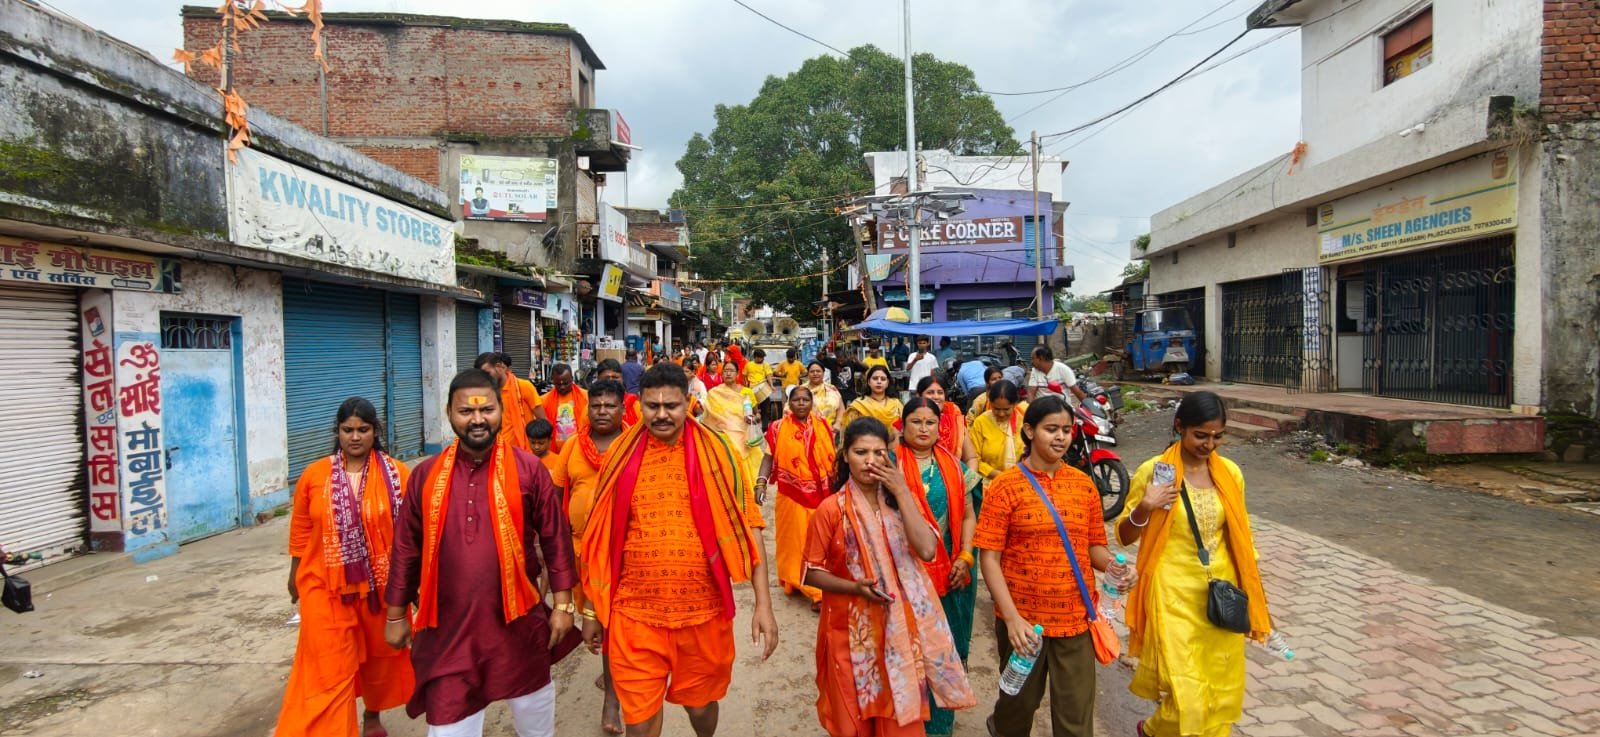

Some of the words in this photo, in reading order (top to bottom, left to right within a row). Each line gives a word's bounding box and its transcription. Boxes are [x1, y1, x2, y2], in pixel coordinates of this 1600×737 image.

[258, 167, 371, 227] KWALITY
[376, 205, 442, 246] STORES
[1367, 219, 1402, 242] SHEEN
[1405, 206, 1472, 234] AGENCIES
[898, 223, 941, 241] CKE
[945, 220, 1016, 240] CORNER
[48, 272, 96, 285] सर्विस
[88, 425, 118, 520] सर्विस
